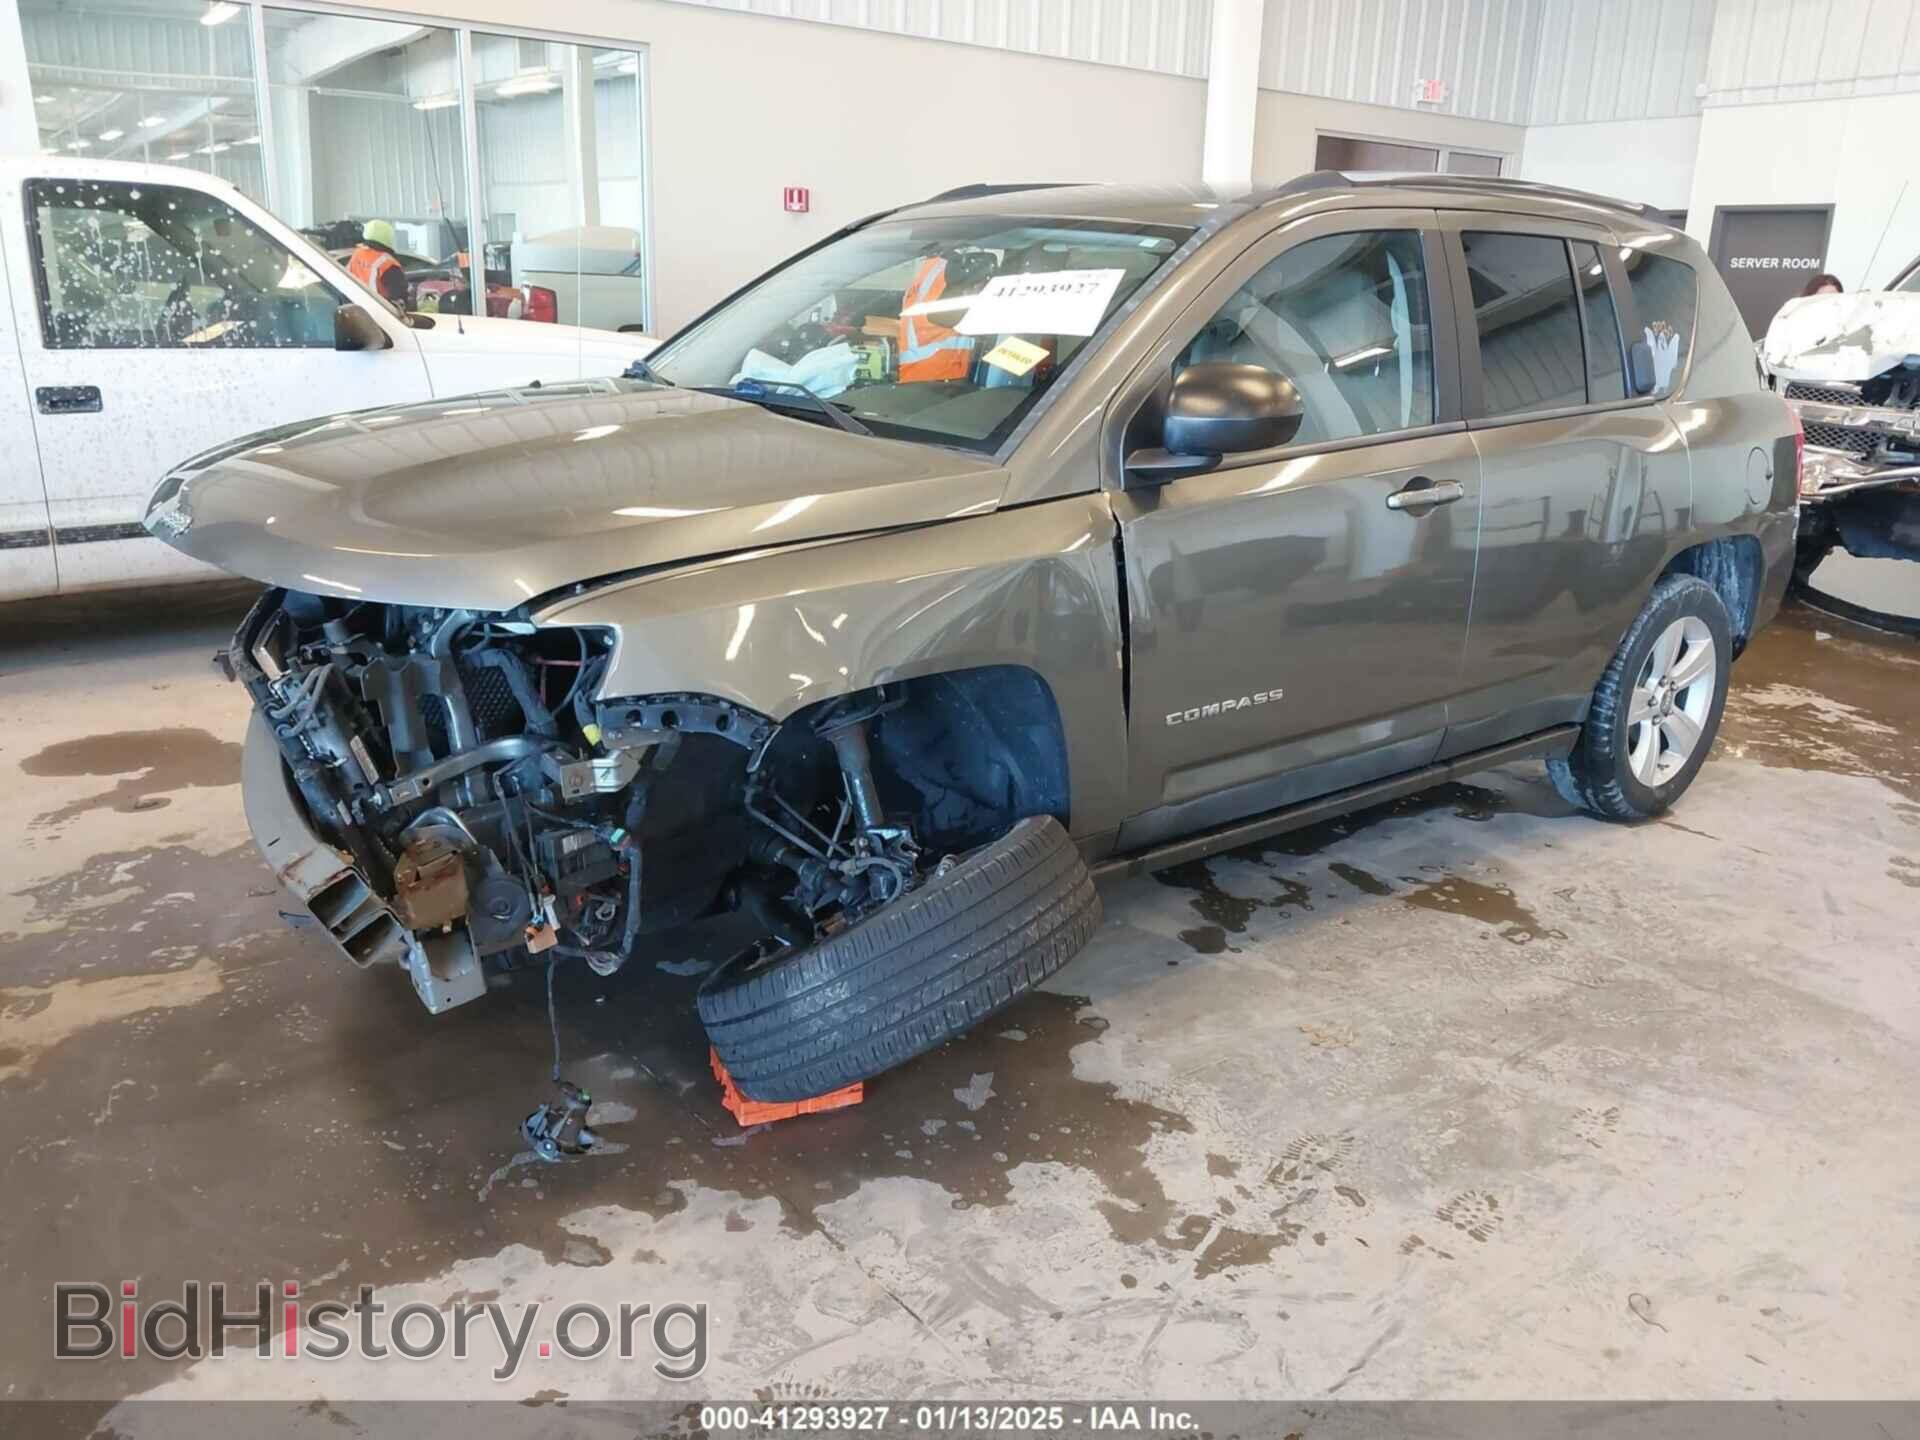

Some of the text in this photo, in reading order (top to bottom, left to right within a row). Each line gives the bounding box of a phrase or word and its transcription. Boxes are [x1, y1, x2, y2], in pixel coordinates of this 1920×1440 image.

[1730, 257, 1820, 269] SERVER ROOM
[1165, 688, 1284, 725] COMPASS
